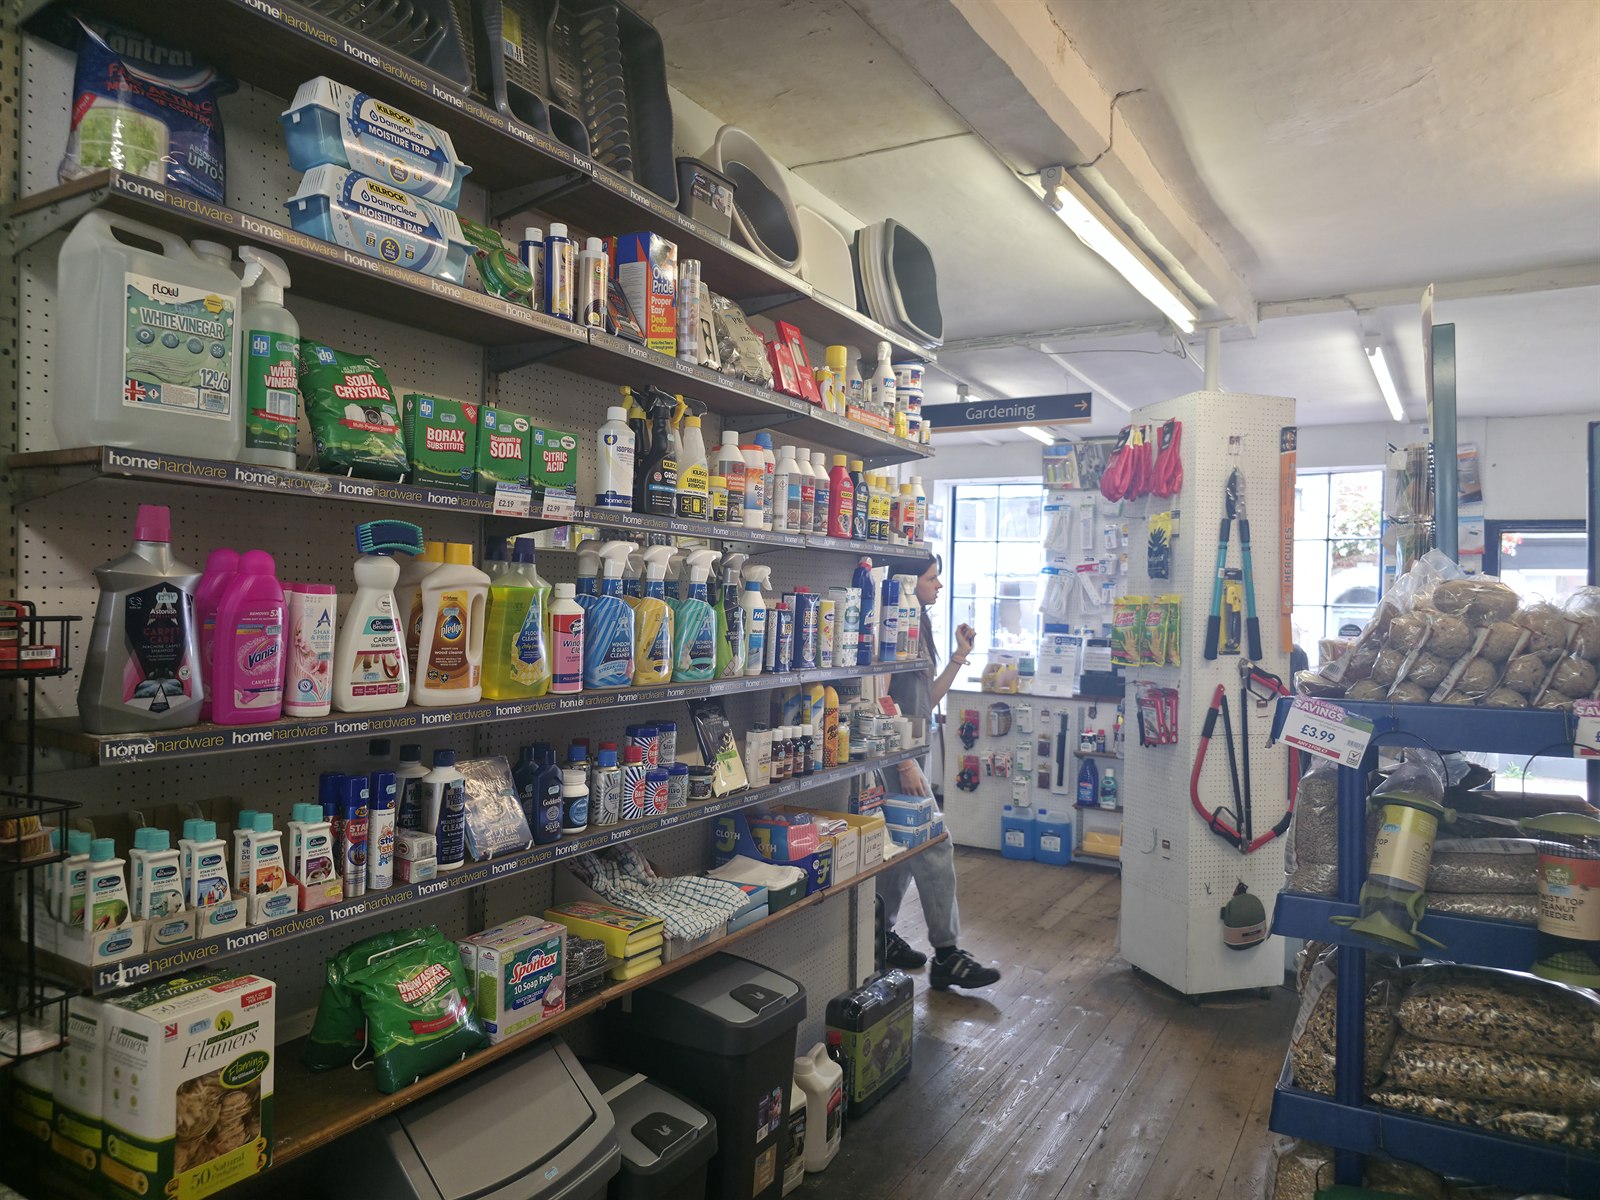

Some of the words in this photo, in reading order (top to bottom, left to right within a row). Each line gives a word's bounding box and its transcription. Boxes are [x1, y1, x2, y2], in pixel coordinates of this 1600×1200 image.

[344, 41, 427, 90] homehardware
[433, 84, 503, 128] homehardware
[375, 104, 413, 126] KILROCK
[379, 115, 425, 141] DampClear
[368, 125, 410, 150] MOISTURE
[410, 143, 431, 158] TRAP
[508, 122, 569, 160] homehardware
[114, 176, 233, 224] homehardware
[368, 183, 406, 204] KILROCK
[371, 195, 418, 218] DampClear
[359, 206, 402, 228] MOISTURE
[403, 221, 424, 234] TRAP
[242, 215, 338, 258] homehardware
[344, 251, 426, 287] homehardware
[432, 280, 501, 311] homehardware
[652, 281, 674, 295] Pride
[651, 297, 671, 307] Proper
[651, 306, 665, 316] Easy
[141, 308, 177, 329] WHITE
[177, 315, 225, 339] VINEGAR
[651, 315, 667, 326] Deep
[651, 323, 674, 333] Cleaner
[253, 338, 267, 354] dp
[319, 348, 333, 363] dp
[200, 368, 229, 392] 12%
[270, 366, 297, 378] WHITE
[345, 374, 377, 387] SODA
[333, 385, 391, 401] CRYSTALS
[421, 401, 432, 416] dp
[965, 404, 1036, 421] Gardening
[485, 411, 496, 428] dp
[426, 427, 465, 444] BORAX
[535, 430, 544, 445] dp
[426, 440, 465, 453] SUBSTITUTE
[490, 443, 522, 460] SODA
[109, 451, 227, 478] homehardware
[543, 450, 568, 463] CITRIC
[546, 461, 565, 473] ACID
[339, 482, 422, 502] homehardware
[498, 498, 515, 508] £2.19
[546, 504, 561, 513] £2.99
[622, 515, 668, 529] homehardware
[671, 520, 711, 534] homehardware
[1284, 526, 1293, 583] HERCULES
[753, 610, 765, 618] HG
[440, 623, 463, 638] pledge
[248, 641, 280, 668] Vanish
[617, 688, 664, 702] homehardware
[422, 708, 491, 725] homehardware
[496, 700, 556, 716] homehardware
[1294, 699, 1344, 722] SAVINGS
[334, 714, 416, 734] homehardware
[232, 722, 328, 745] homehardware
[1300, 724, 1335, 743] £3.99
[545, 821, 561, 832] SILVER
[906, 816, 914, 825] M
[612, 820, 658, 840] homehardware
[715, 830, 741, 840] CLOTH
[556, 834, 608, 857] homehardware
[492, 849, 552, 874] homehardware
[418, 869, 487, 896] homehardware
[331, 889, 413, 921] homehardware
[1541, 901, 1577, 914] PEANUT
[1563, 897, 1585, 907] TOP
[1541, 908, 1576, 922] FEEDER
[227, 912, 324, 951] homehardware
[508, 951, 558, 985] Spontex
[514, 984, 522, 995] 10
[522, 979, 539, 992] Soap
[539, 972, 554, 985] Pads
[245, 993, 257, 1002] ONLY
[180, 1027, 260, 1071] Flamers
[227, 1053, 268, 1077] Flaming
